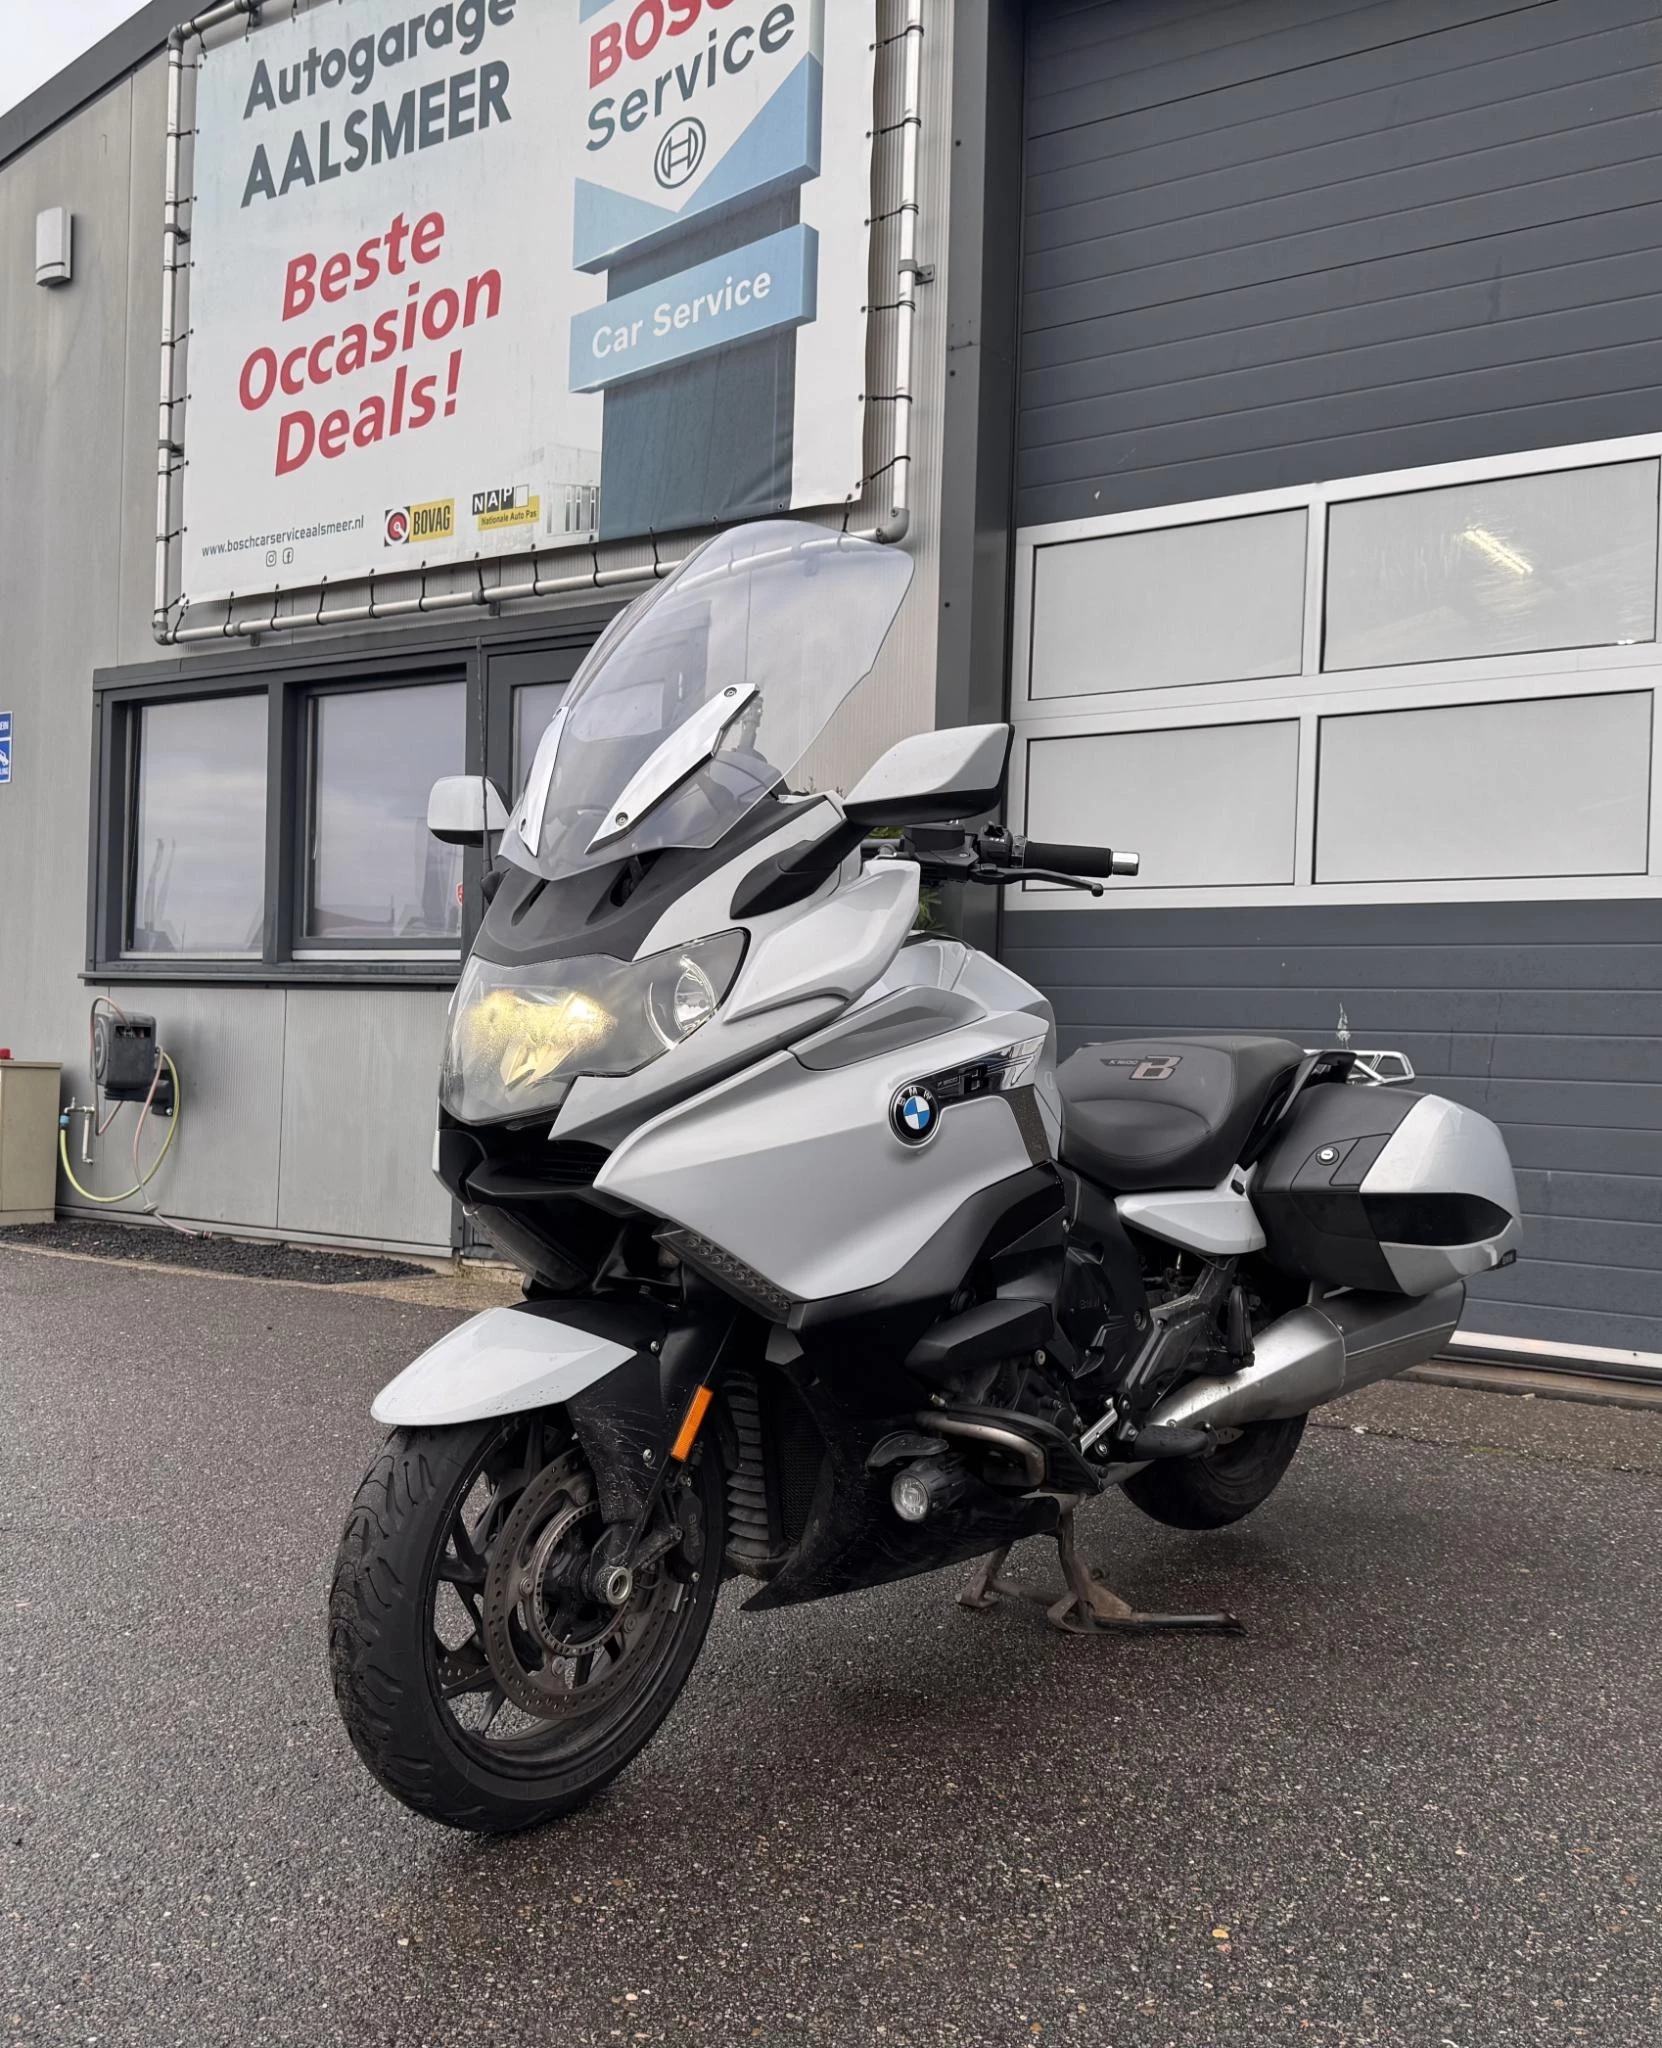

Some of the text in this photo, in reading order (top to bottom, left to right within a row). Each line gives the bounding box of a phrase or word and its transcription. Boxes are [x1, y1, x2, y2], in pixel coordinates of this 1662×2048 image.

[243, 0, 517, 120] Autogarage
[586, 3, 795, 151] Service
[589, 0, 737, 90] BOS
[240, 60, 512, 208] AALSMEER
[282, 211, 445, 322] Beste
[239, 268, 502, 411] Occasion
[592, 271, 772, 358] Car Service
[275, 348, 463, 477] Deals!
[201, 515, 364, 557] www.boschcarserviceaalsmeer.nl
[413, 505, 451, 535] BOVAG
[473, 487, 513, 513] NAP
[481, 508, 537, 526] Nationale Auto Pas
[897, 1087, 933, 1106] BMW
